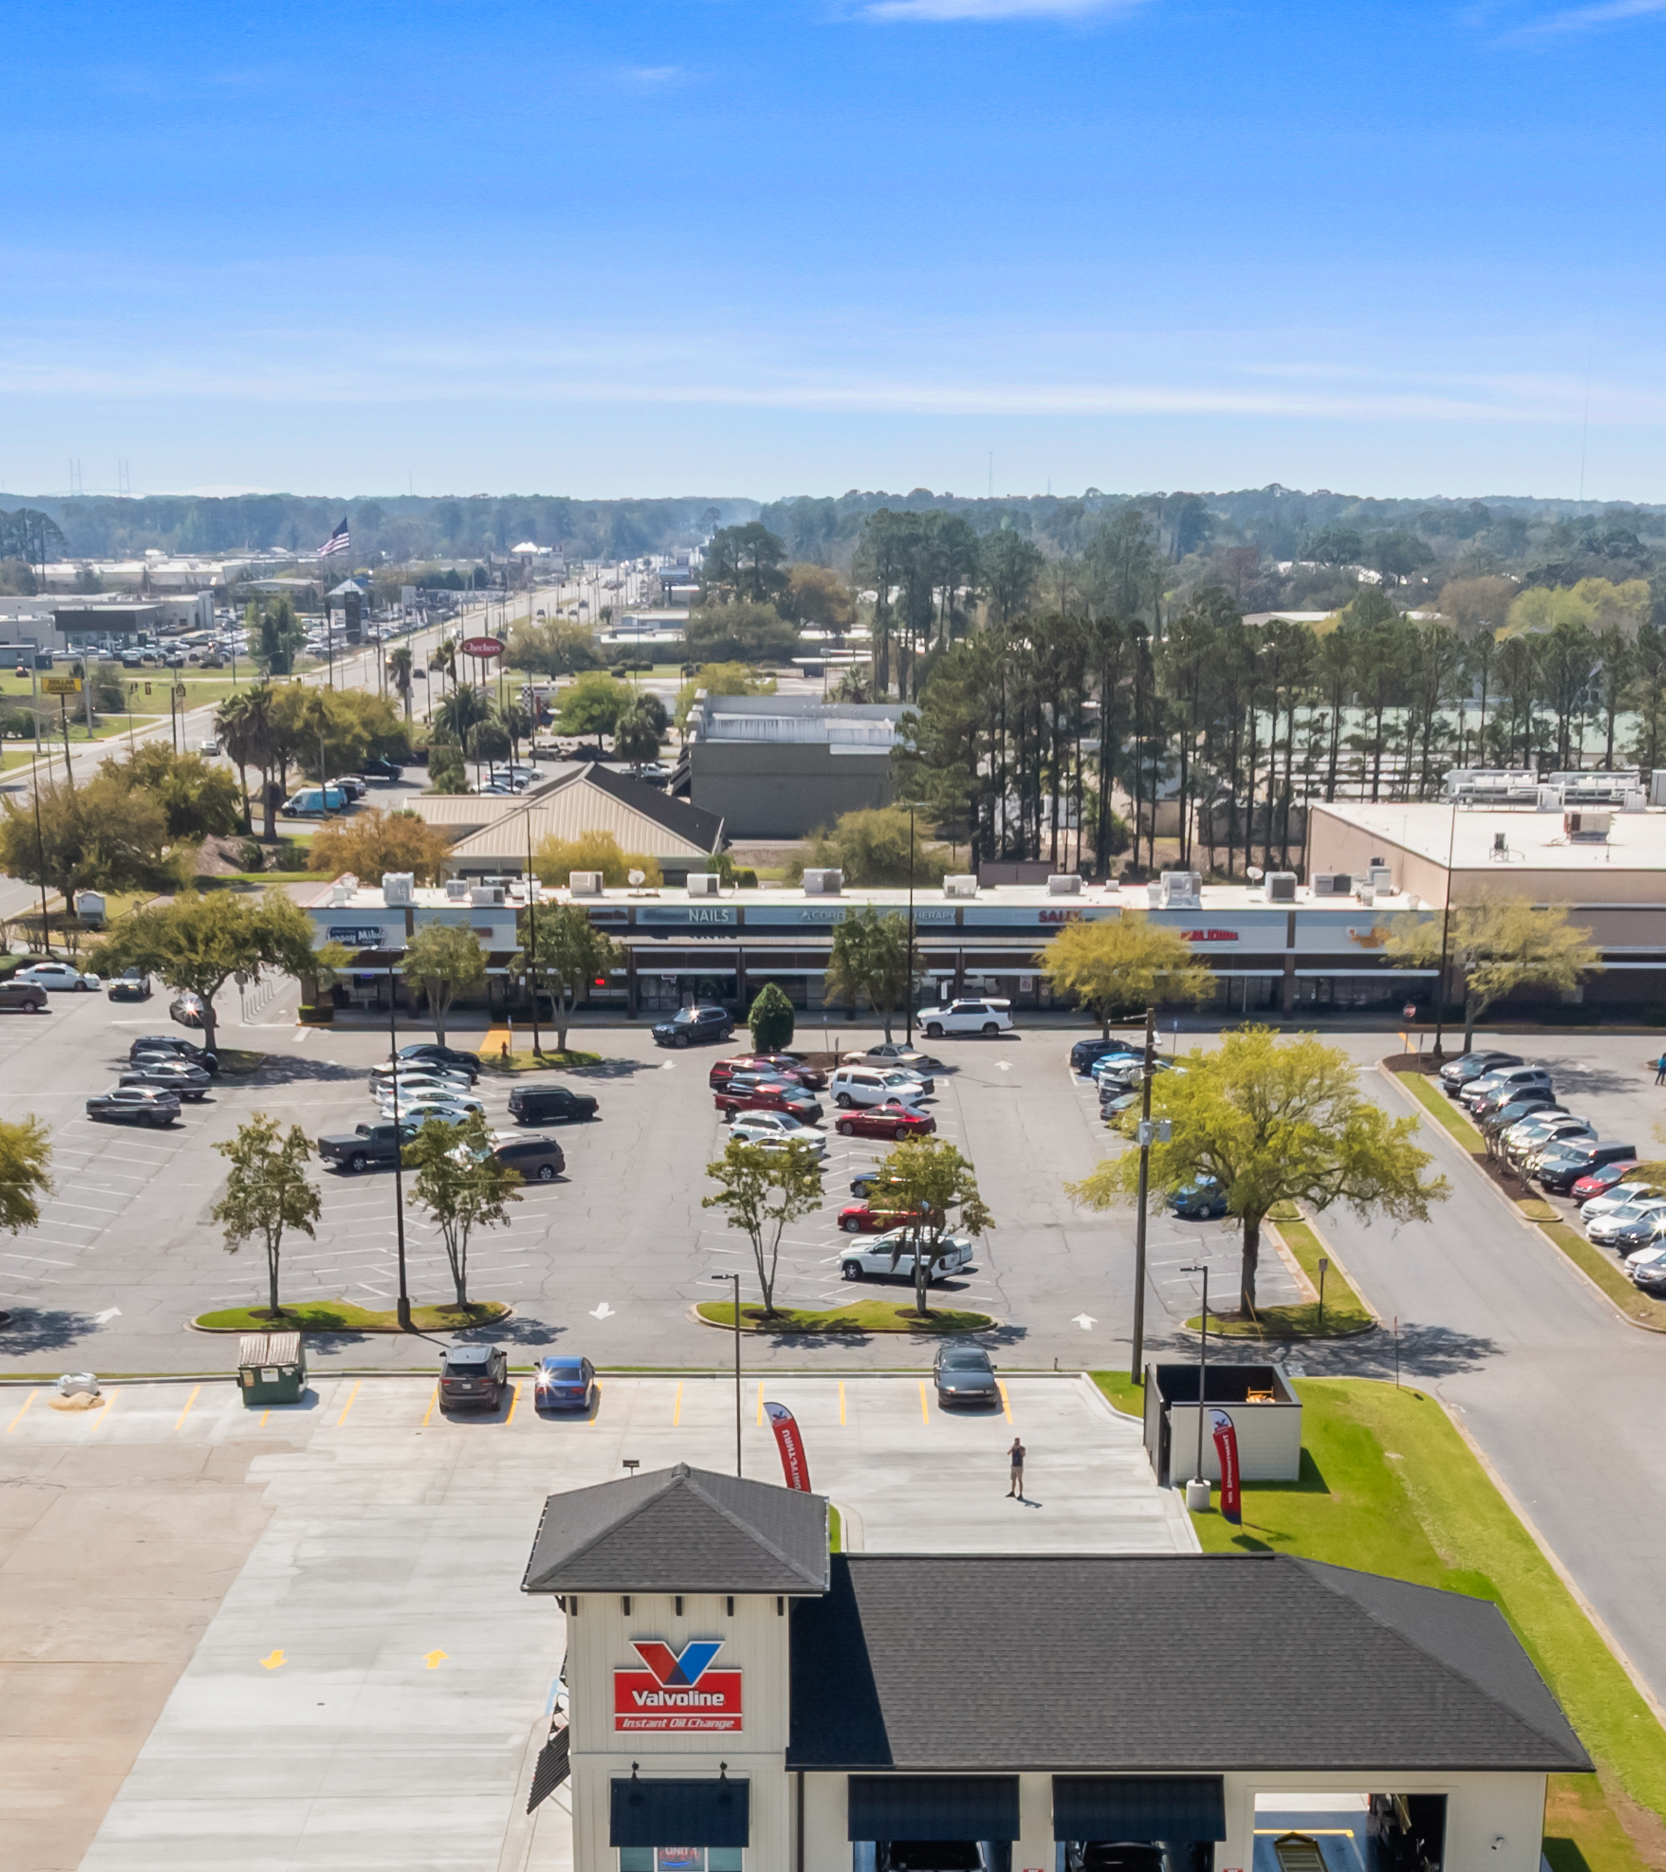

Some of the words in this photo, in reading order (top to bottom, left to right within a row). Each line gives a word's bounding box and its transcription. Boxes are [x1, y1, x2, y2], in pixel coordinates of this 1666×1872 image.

[463, 642, 501, 652] Checkers
[688, 908, 729, 922] NAILS
[915, 911, 956, 920] HERAPY
[632, 1690, 725, 1706] Valvoline
[622, 1718, 668, 1728] Instant
[669, 1718, 687, 1728] Oil
[688, 1718, 735, 1730] Change
